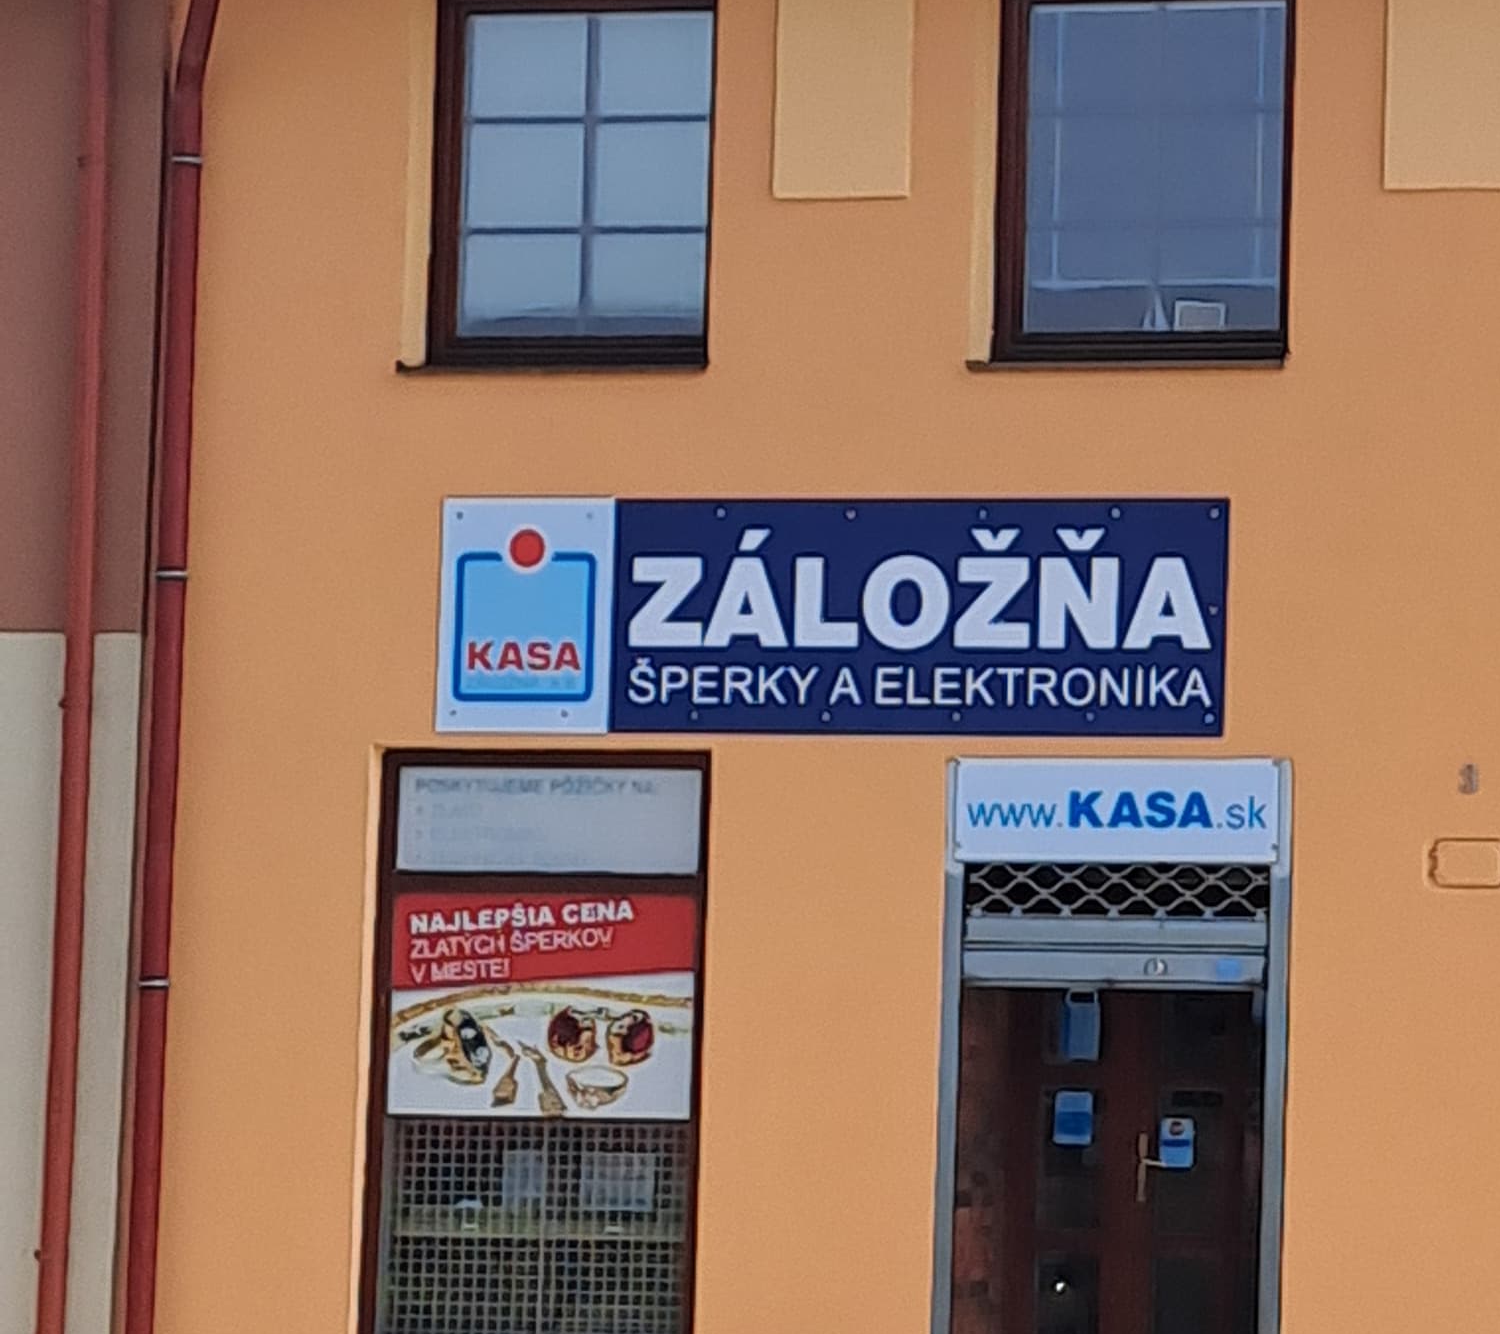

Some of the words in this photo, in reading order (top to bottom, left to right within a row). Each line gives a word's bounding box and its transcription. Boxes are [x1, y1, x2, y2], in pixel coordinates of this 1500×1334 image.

[628, 528, 1211, 649] ZÁLOŽŇA
[467, 641, 581, 670] KASA
[627, 657, 819, 704] ŠPERKY
[829, 667, 861, 705] A
[874, 666, 1212, 707] ELEKTRONIKA
[966, 790, 1267, 830] www.KASA.sk
[410, 902, 556, 935] NAJLEPŠIA
[561, 900, 634, 924] CENA
[410, 931, 505, 959] ZLATÝCH
[510, 927, 613, 953] ŠPERKOV
[410, 963, 426, 984] V
